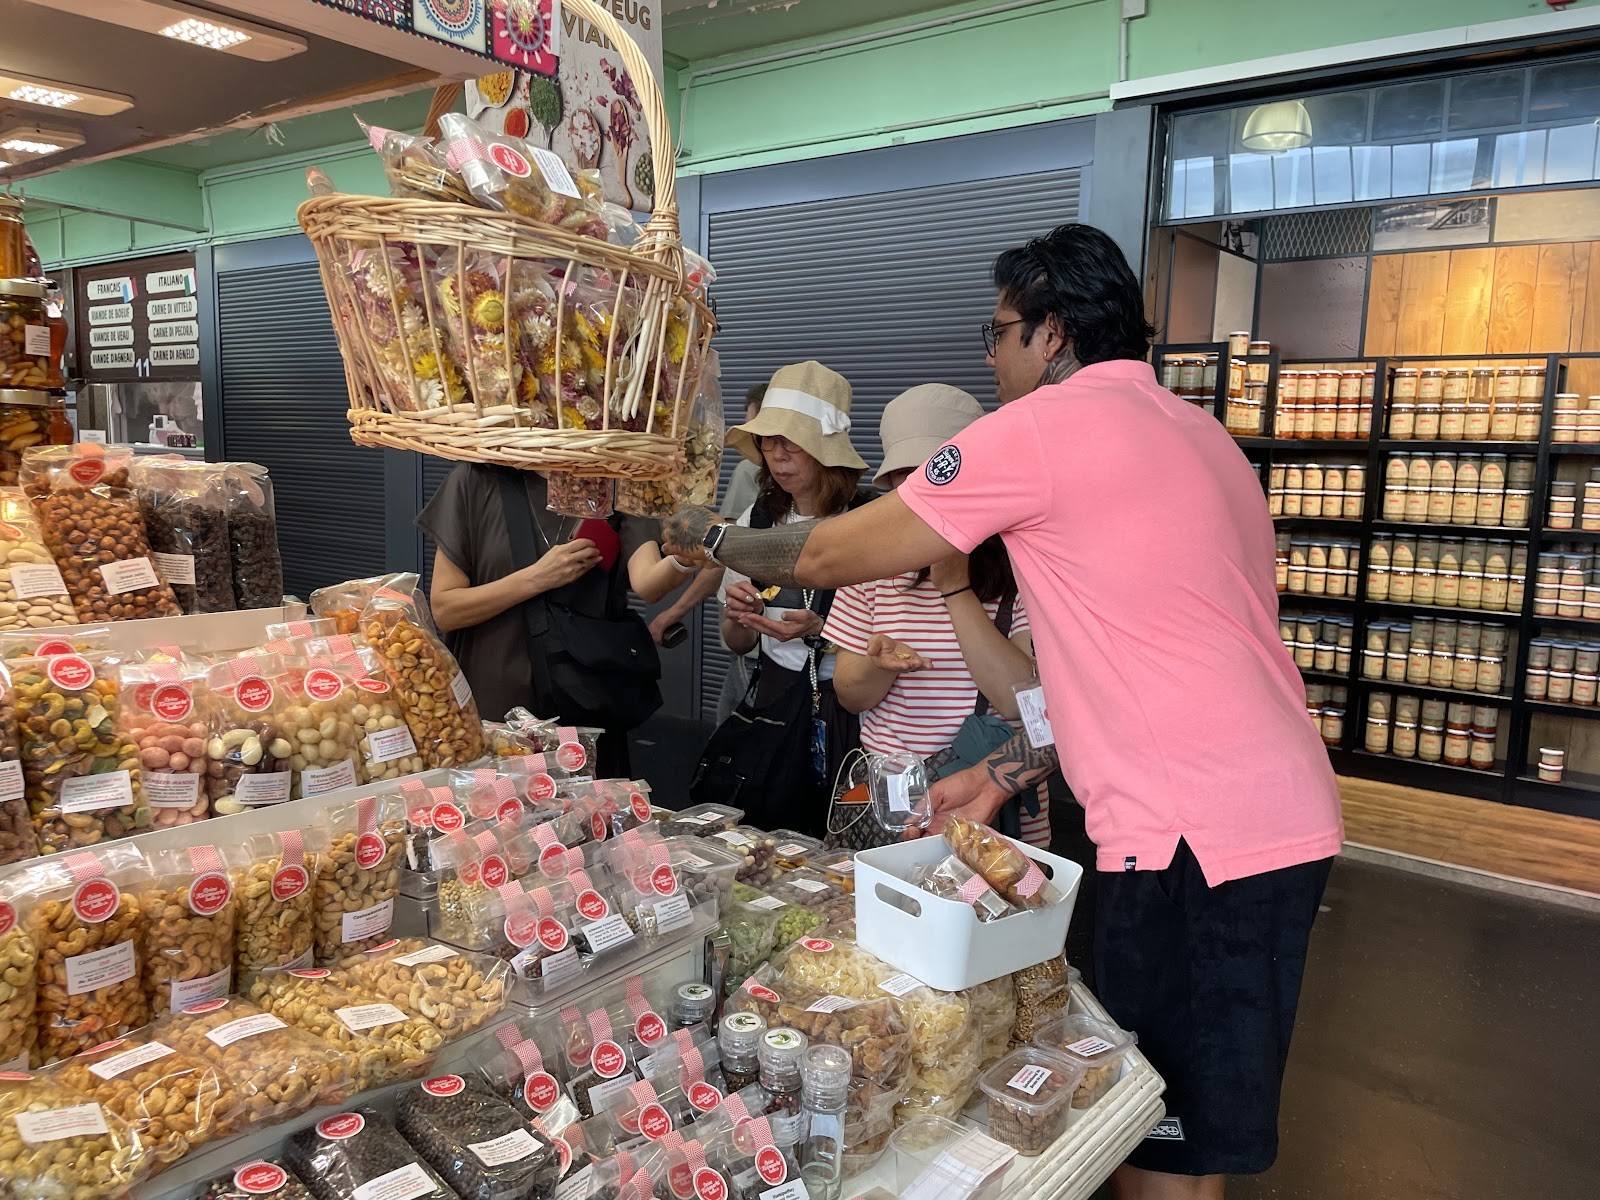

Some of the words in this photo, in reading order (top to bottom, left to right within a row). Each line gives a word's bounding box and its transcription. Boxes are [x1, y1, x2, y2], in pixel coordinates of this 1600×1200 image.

[158, 273, 184, 287] ITALIANO
[91, 310, 108, 321] VIANDE
[108, 309, 115, 320] DE
[115, 307, 130, 319] BOEUF
[151, 303, 167, 315] CARNE
[167, 303, 173, 314] DI
[93, 331, 110, 342] VIANDE
[110, 331, 117, 341] DE
[117, 330, 130, 341] VEAU
[152, 327, 169, 338] CARNE
[169, 326, 175, 337] DI
[175, 325, 194, 337] PECORA
[92, 353, 110, 364] VIANDE
[152, 350, 169, 361] CARNE
[169, 350, 175, 360] DI
[136, 358, 150, 377] 11
